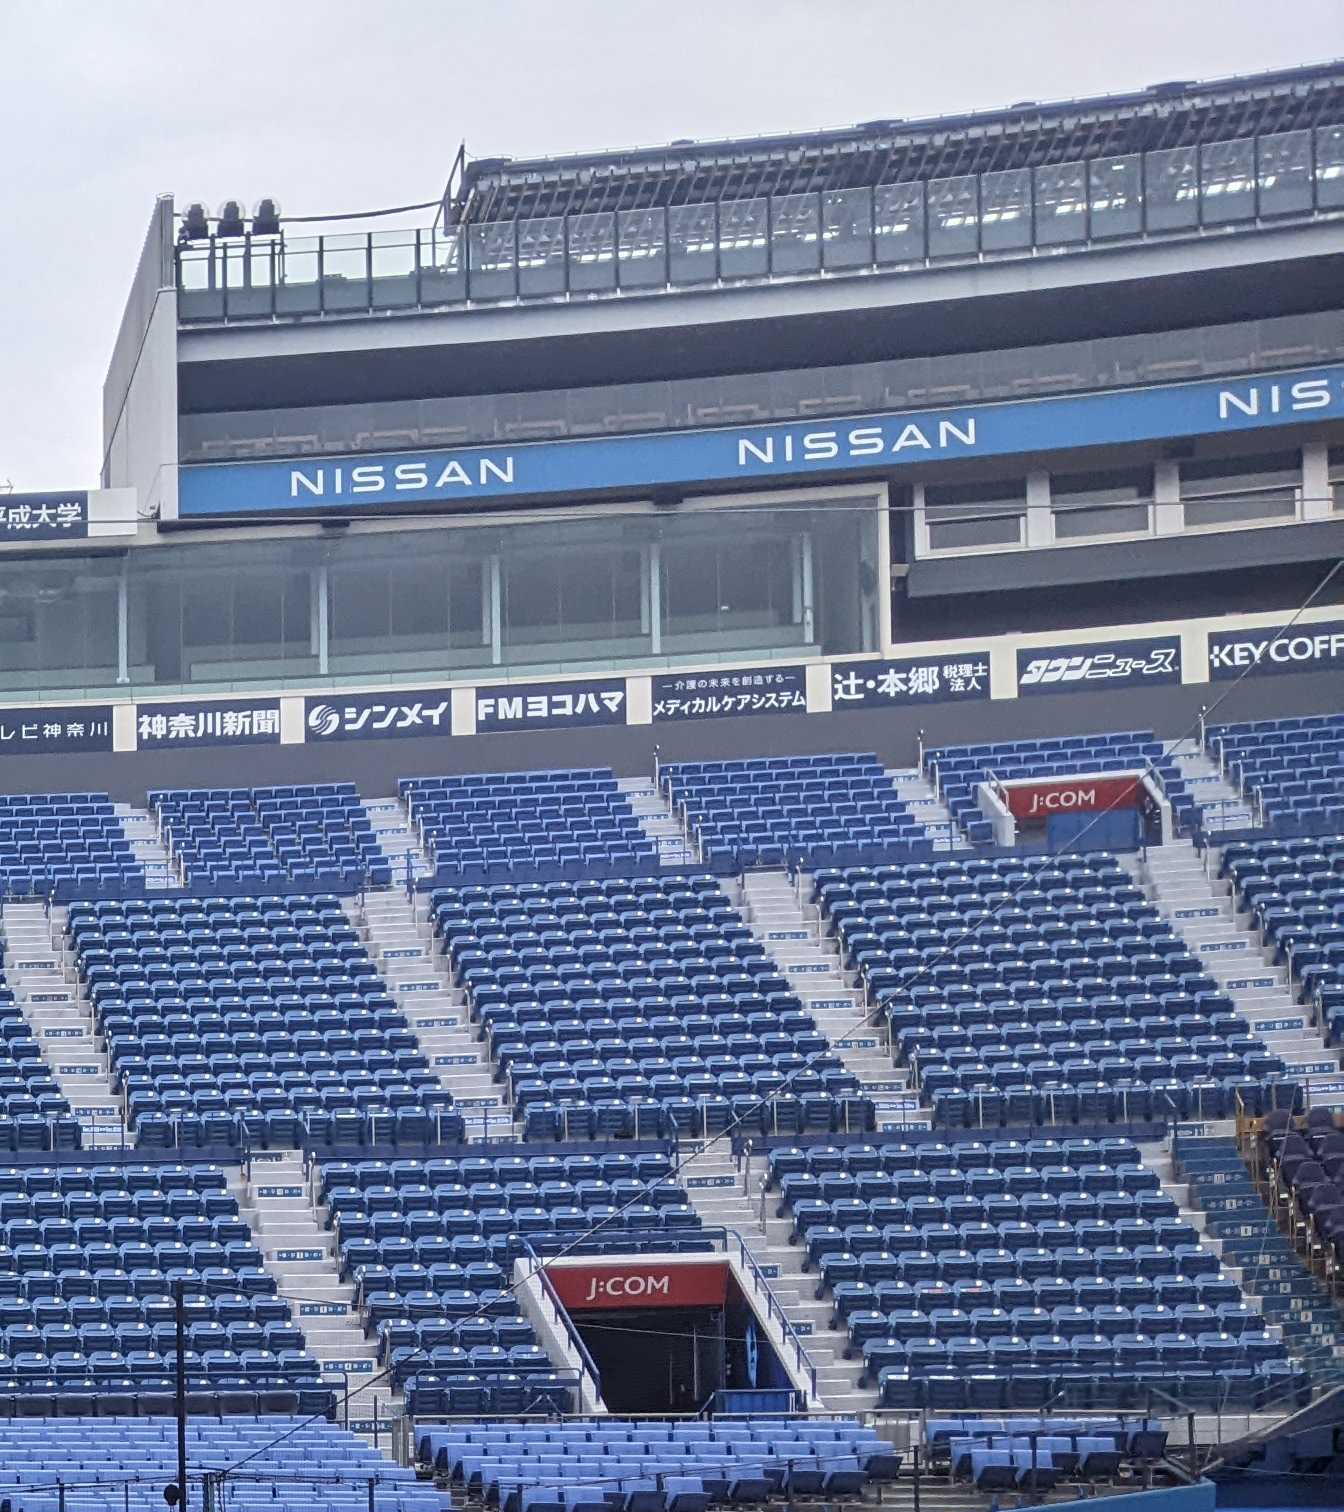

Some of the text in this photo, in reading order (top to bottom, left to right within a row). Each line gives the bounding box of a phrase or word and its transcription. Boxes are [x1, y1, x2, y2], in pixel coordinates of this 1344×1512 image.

[1219, 379, 1344, 419] NIS
[738, 417, 976, 464] NISSAN
[291, 456, 515, 497] NISSAN
[1019, 649, 1176, 684] タウンニュース
[344, 701, 449, 732] シンメイ
[477, 690, 625, 721] FMヨコハマ
[652, 690, 806, 716] メディカルケアシステム
[137, 709, 281, 742] 神奈川新聞
[1029, 788, 1096, 813] J:COM
[585, 1275, 670, 1301] J:COM
